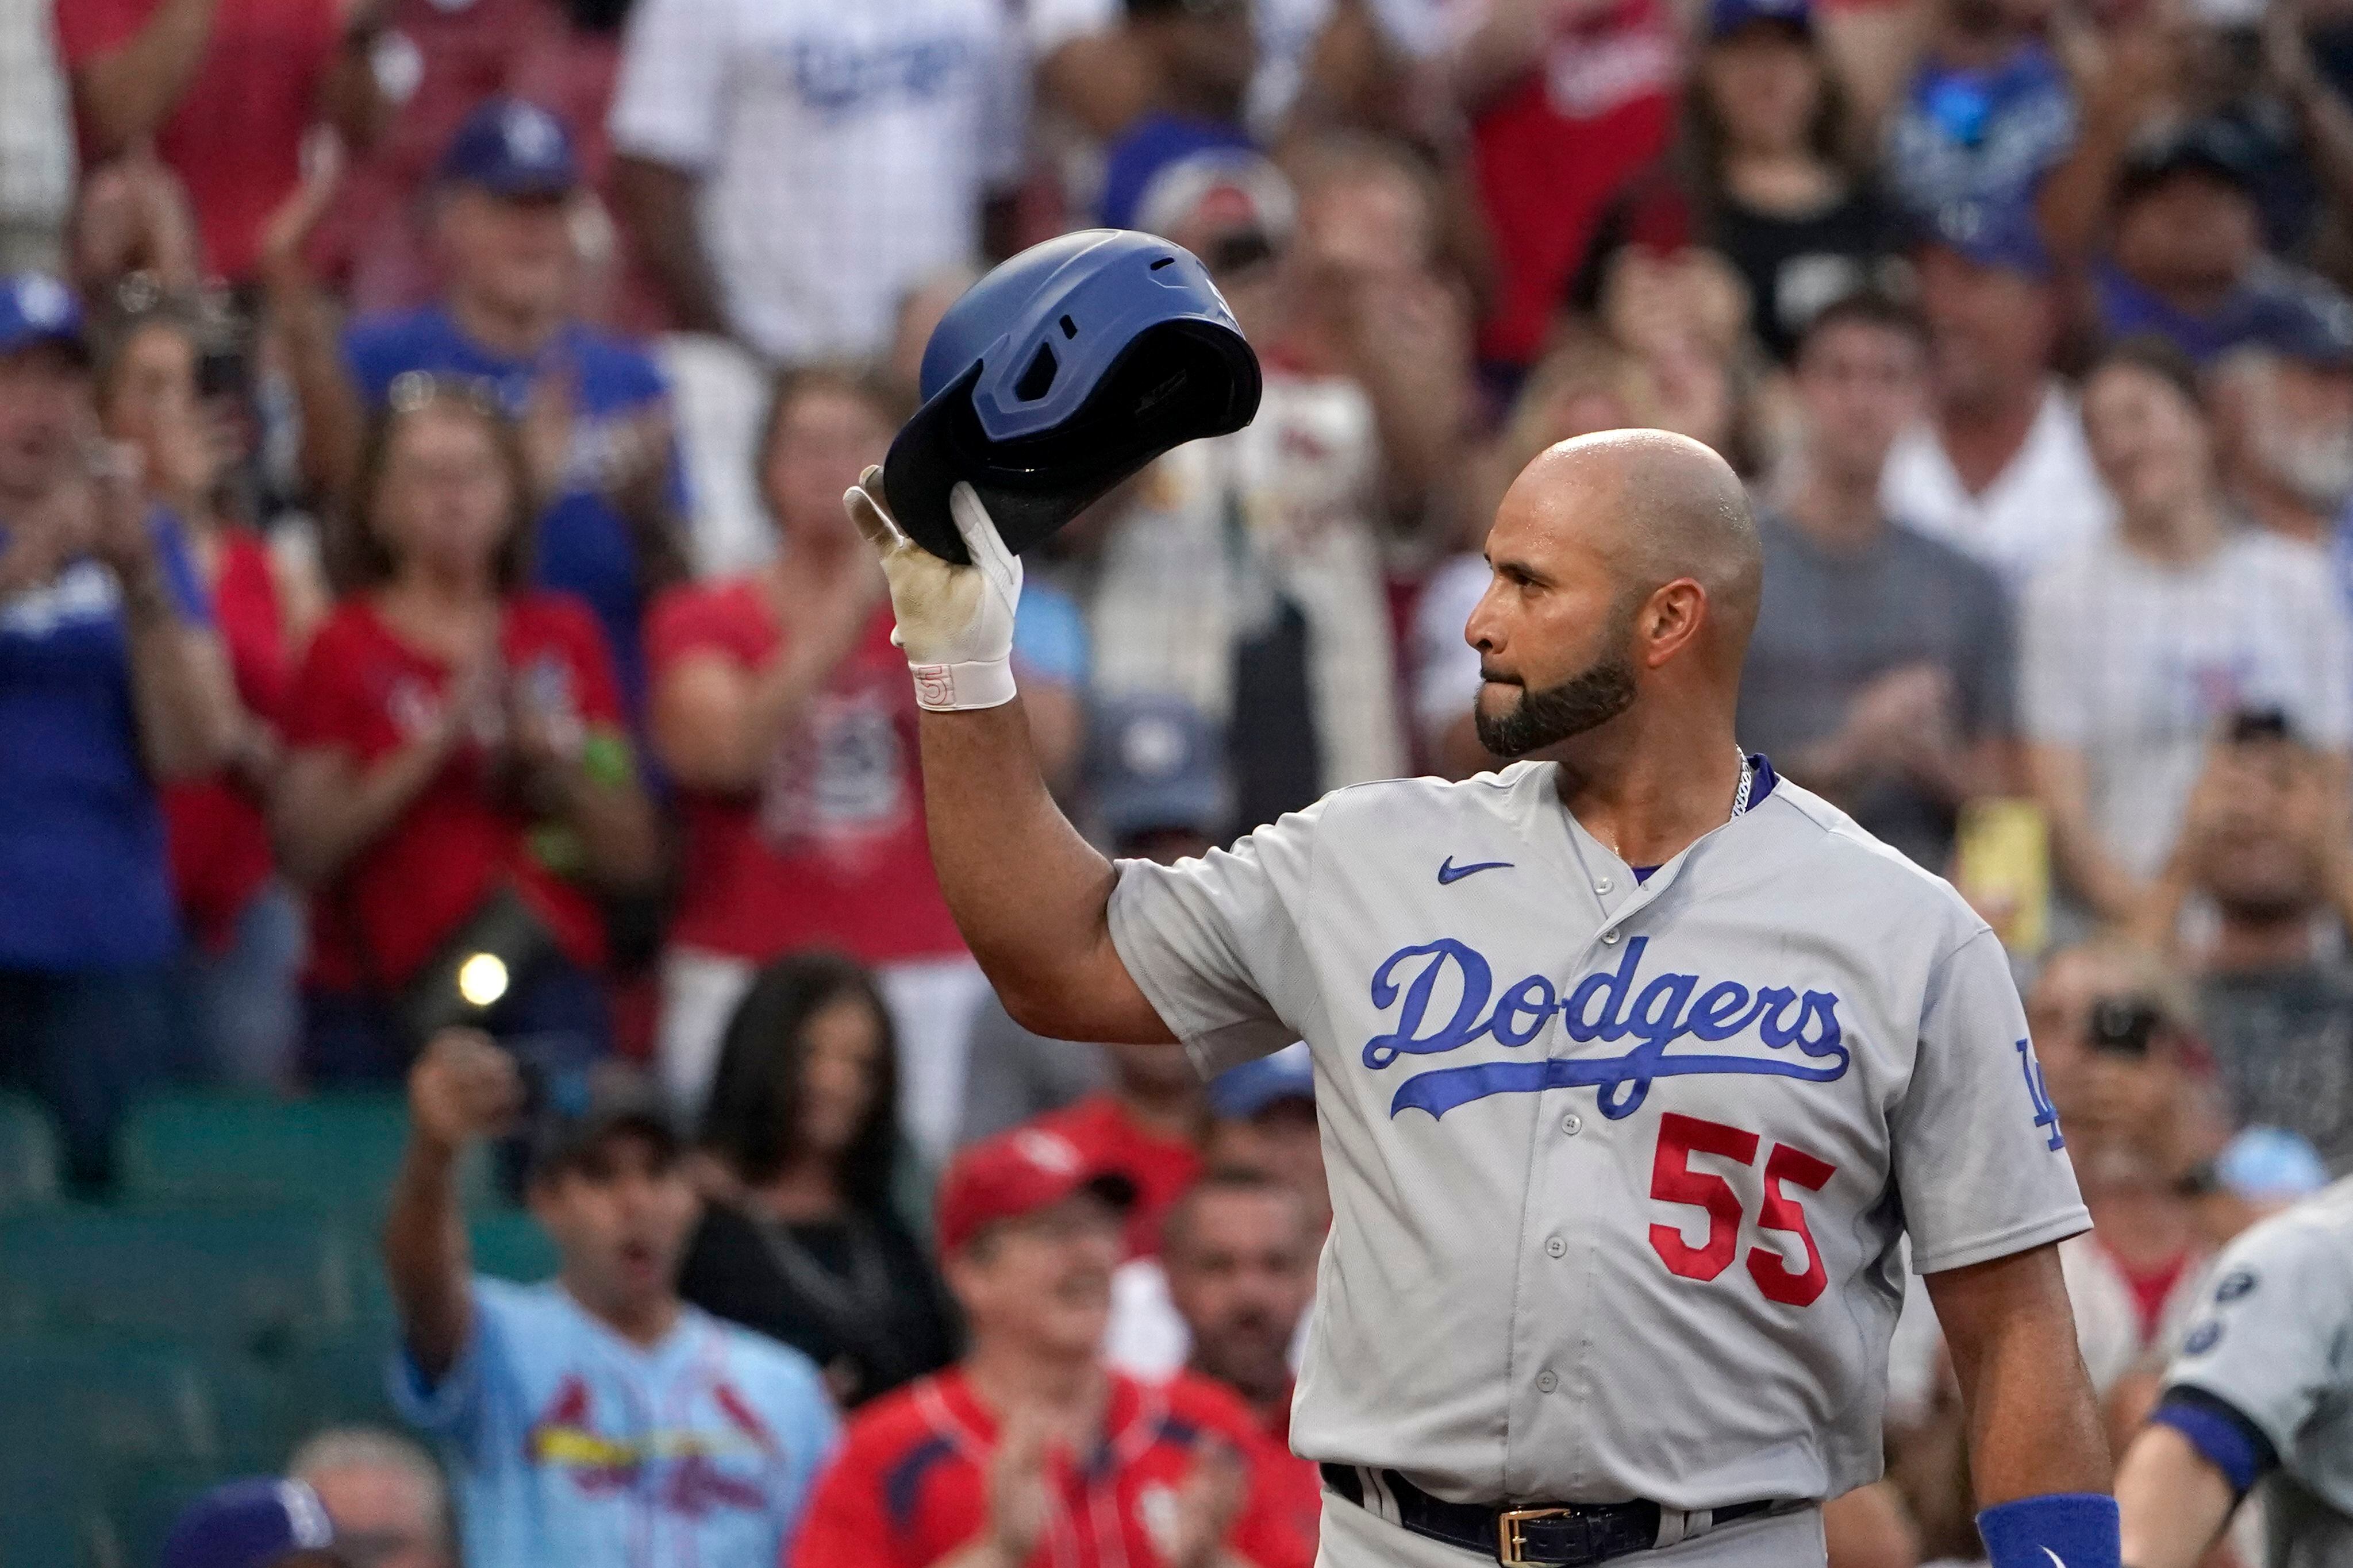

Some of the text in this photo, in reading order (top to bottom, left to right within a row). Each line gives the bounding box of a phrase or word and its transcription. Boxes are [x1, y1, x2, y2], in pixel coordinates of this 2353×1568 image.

[918, 665, 947, 706] 5
[1363, 937, 1849, 1120] Dodgers
[1649, 1112, 1837, 1307] 55
